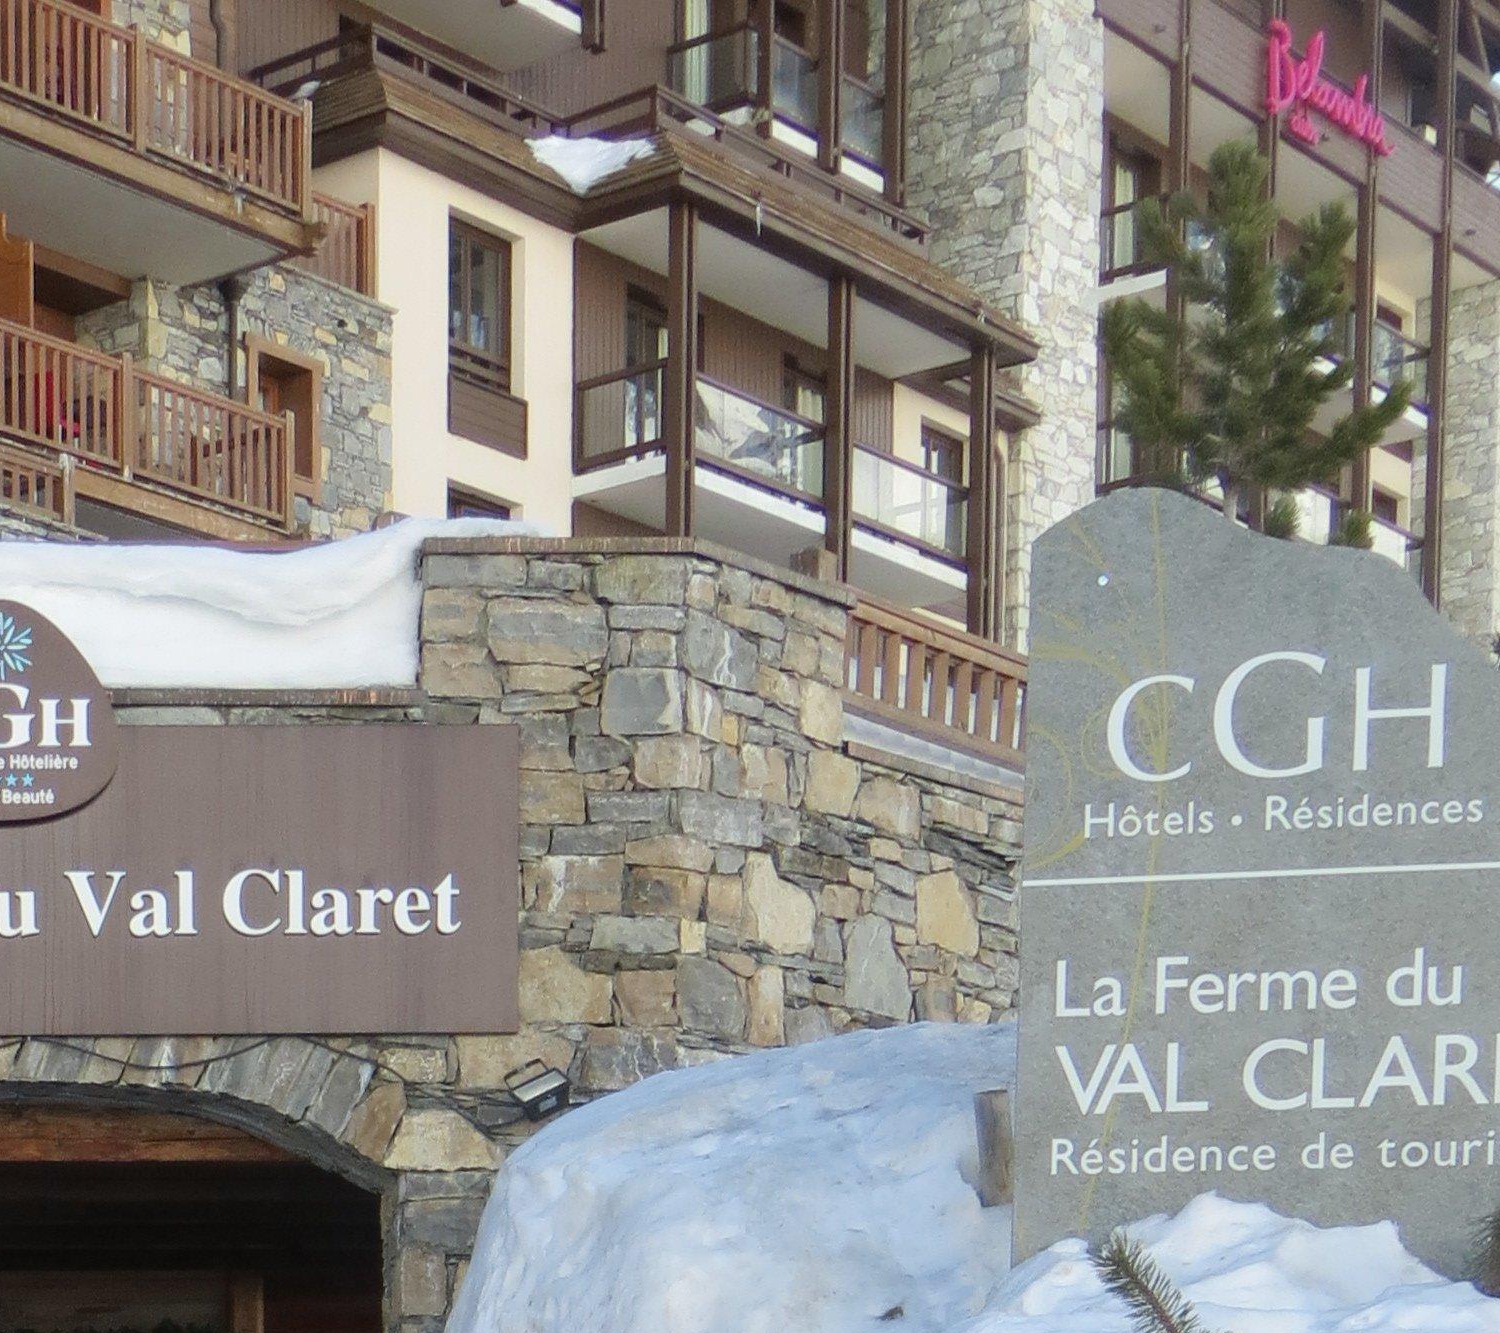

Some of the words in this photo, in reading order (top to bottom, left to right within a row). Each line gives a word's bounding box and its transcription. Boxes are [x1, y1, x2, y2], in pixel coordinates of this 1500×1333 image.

[1107, 651, 1447, 782] CGH
[9, 753, 79, 770] Hôtelière
[2, 788, 55, 805] Beauté
[1083, 800, 1215, 838] Hôtels
[1264, 794, 1484, 831] Résidences
[64, 870, 198, 937] Val
[222, 868, 462, 936] Claret
[1055, 959, 1127, 1018] La
[1155, 955, 1358, 1015] Ferme
[1386, 947, 1463, 1007] du
[1054, 1041, 1209, 1116] VAL
[1242, 1033, 1500, 1111] CLAR
[1050, 1134, 1277, 1175] Résidence
[1301, 1131, 1355, 1170] de
[1379, 1129, 1497, 1168] touri
